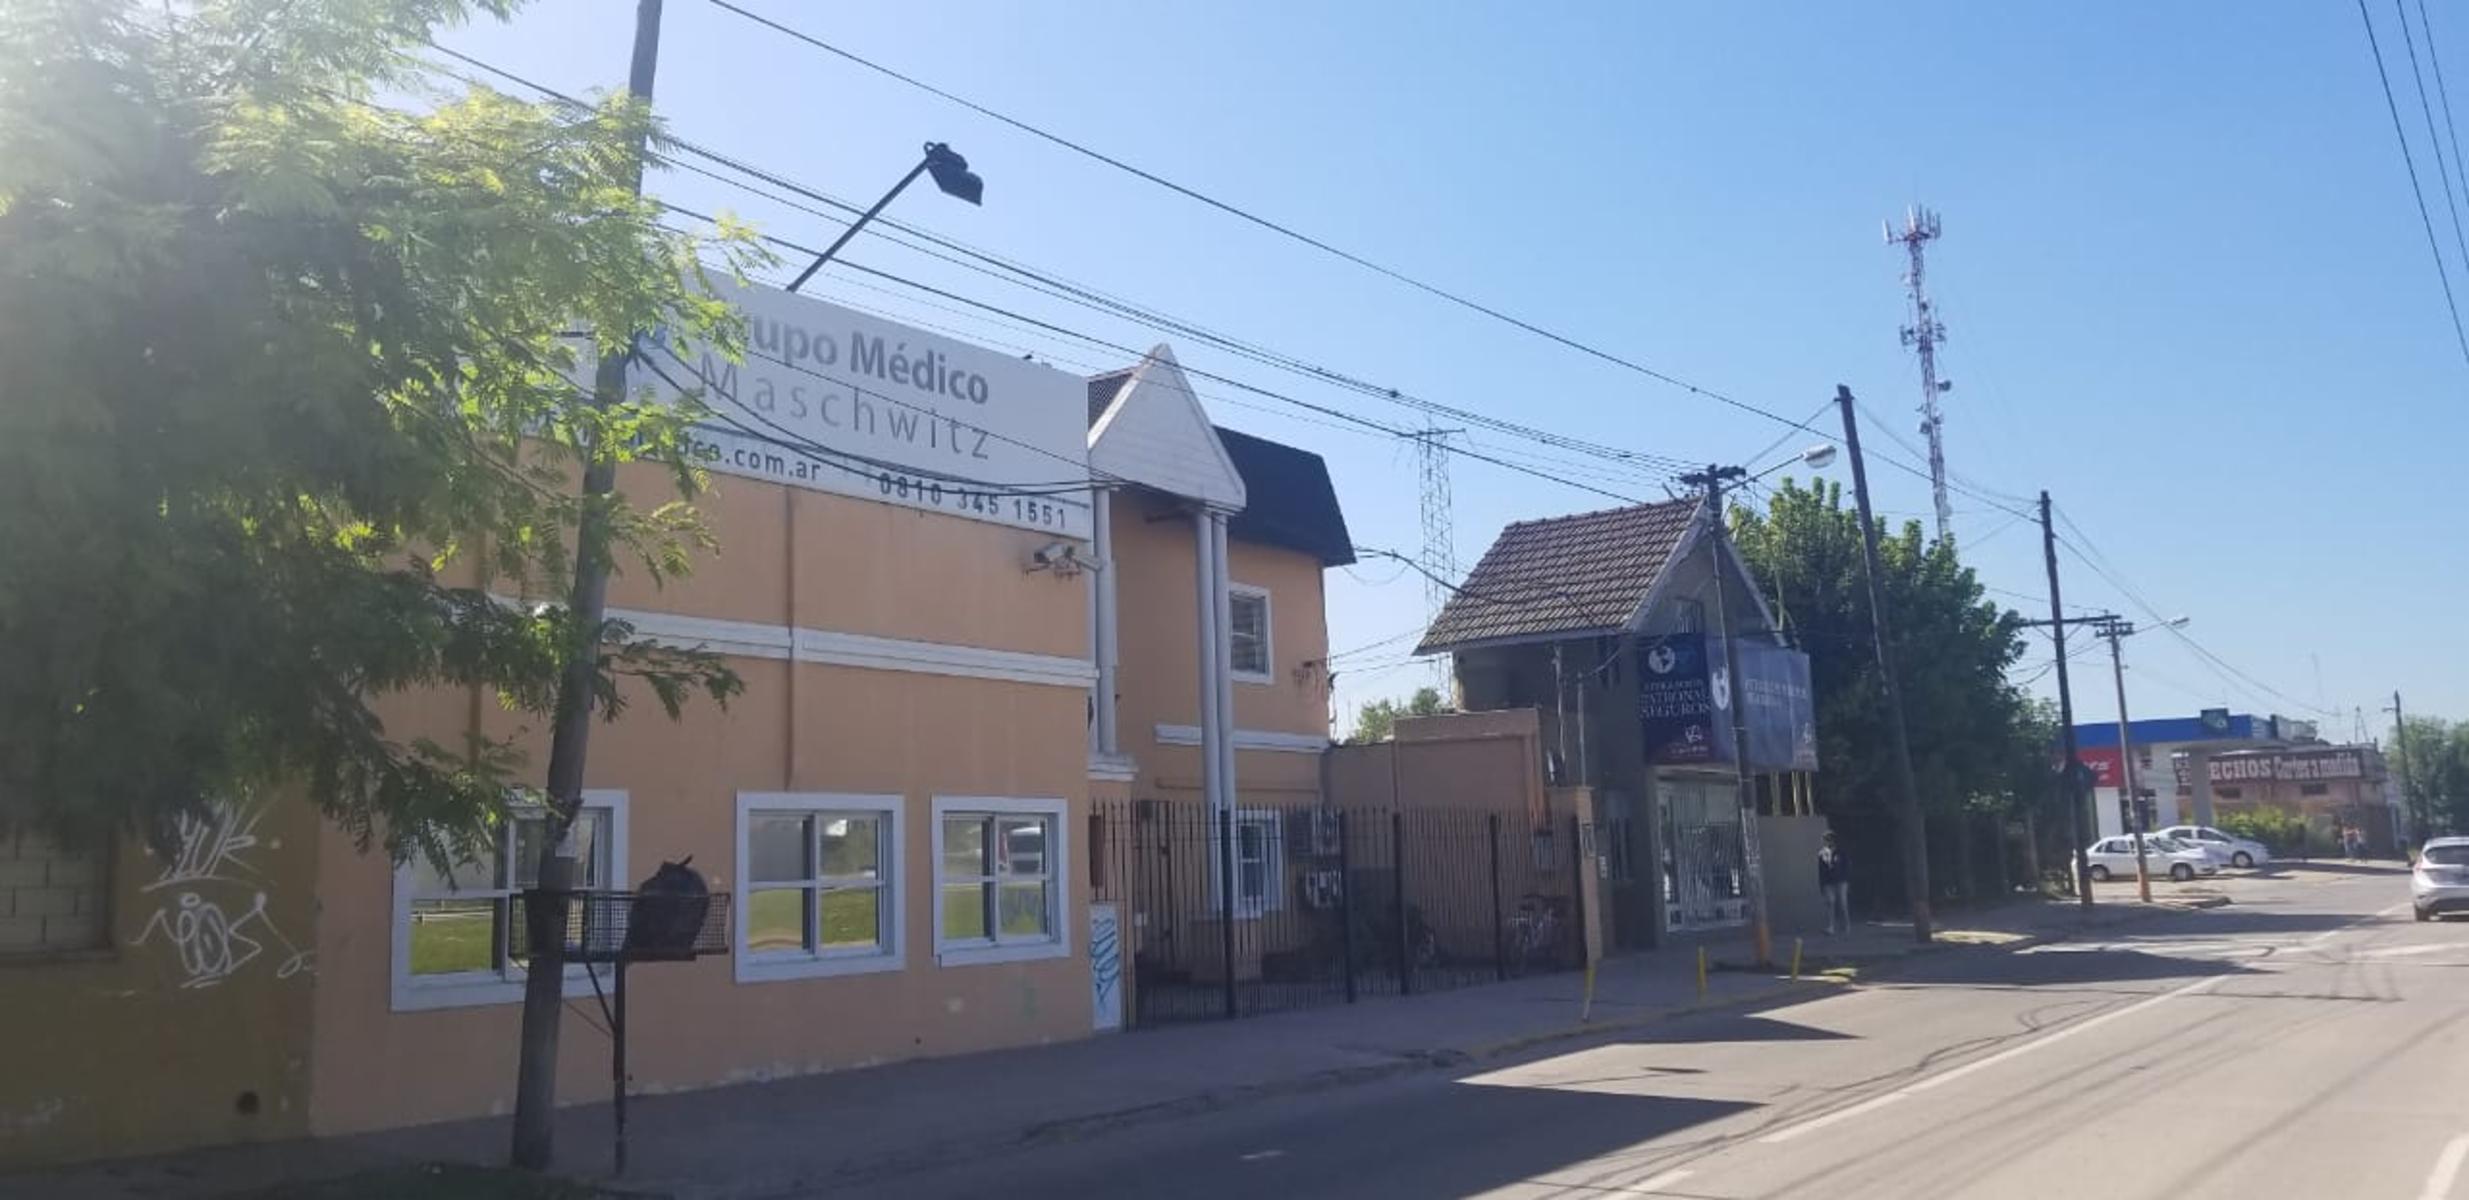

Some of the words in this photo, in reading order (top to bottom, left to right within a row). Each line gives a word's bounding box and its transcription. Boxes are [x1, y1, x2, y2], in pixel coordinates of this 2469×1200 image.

[740, 311, 838, 367] upo
[850, 331, 989, 404] Médico
[701, 351, 989, 460] Maschwitz
[879, 472, 942, 506] 0810
[957, 487, 1000, 515] 345
[1013, 498, 1066, 529] 1551
[2208, 758, 2272, 780] ECHOS
